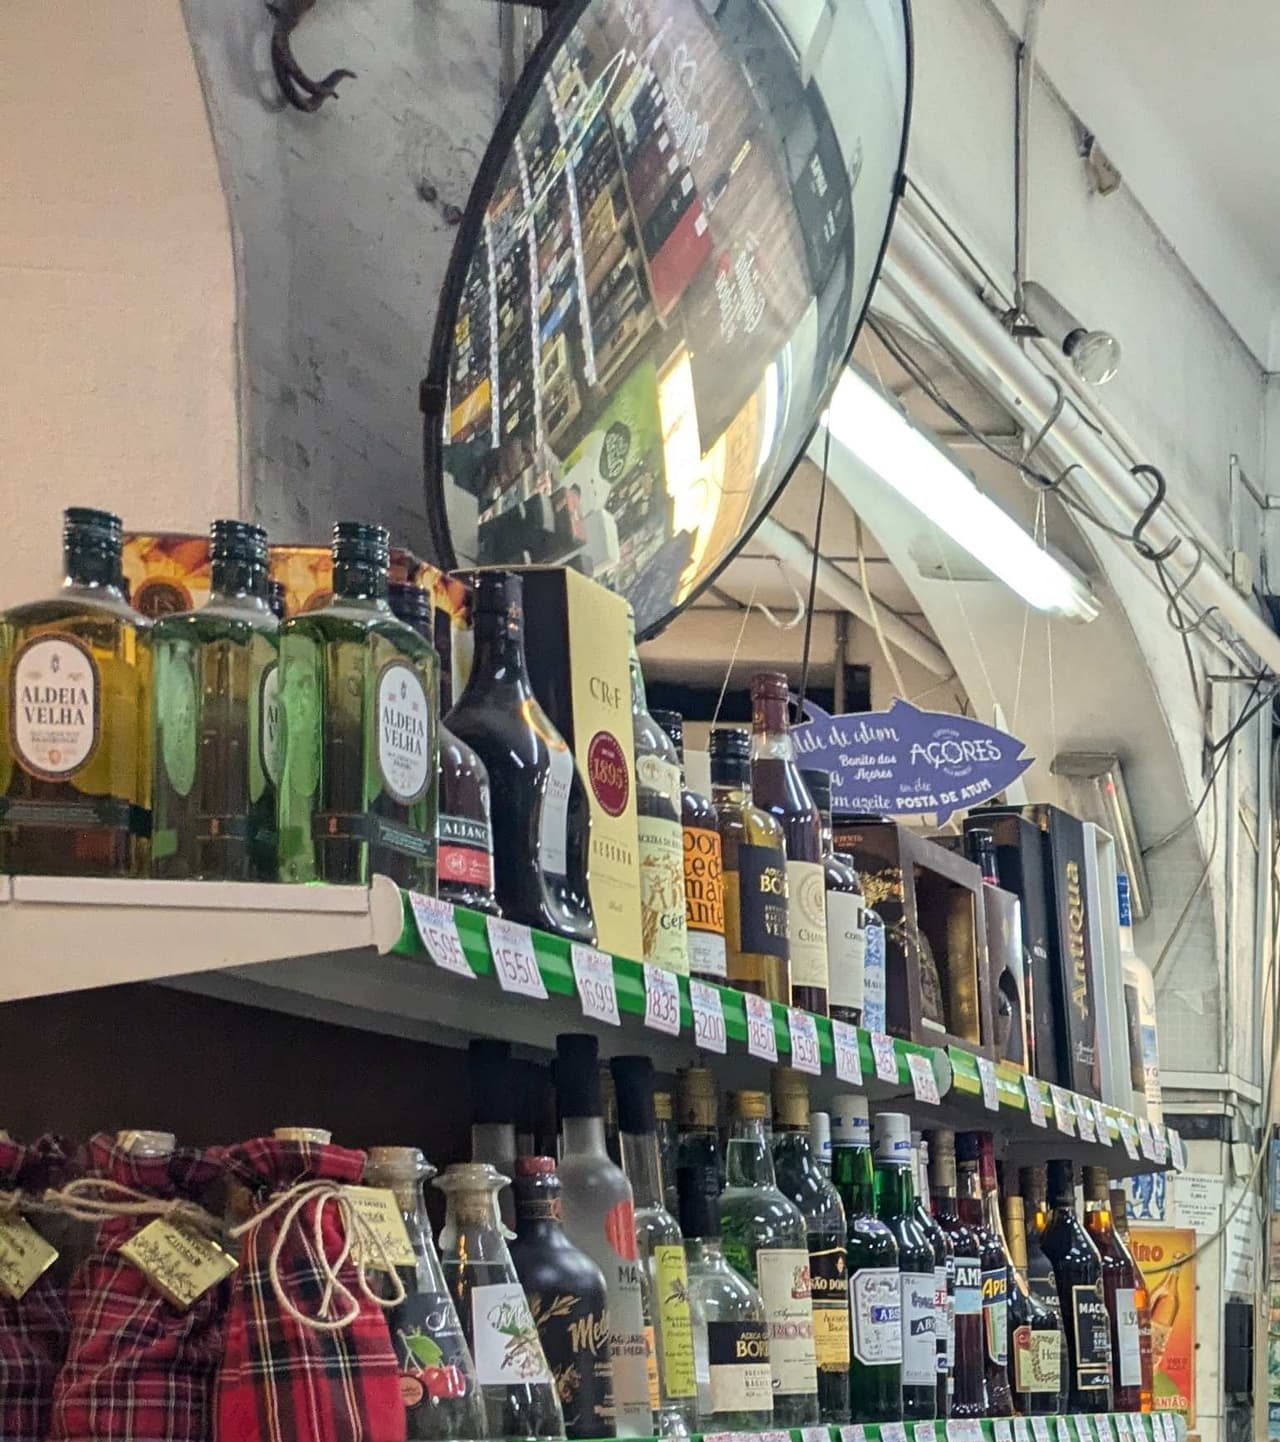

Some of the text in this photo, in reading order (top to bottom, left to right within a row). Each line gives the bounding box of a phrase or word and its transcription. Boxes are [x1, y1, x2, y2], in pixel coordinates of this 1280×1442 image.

[22, 685, 89, 706] ALDEIA
[23, 706, 86, 726] VELHA
[382, 704, 426, 739] ALDEIA
[382, 725, 423, 757] VELHA
[909, 738, 1002, 770] AÇORES
[593, 755, 624, 790] 1895
[896, 777, 993, 809] POSTA DE ATUM
